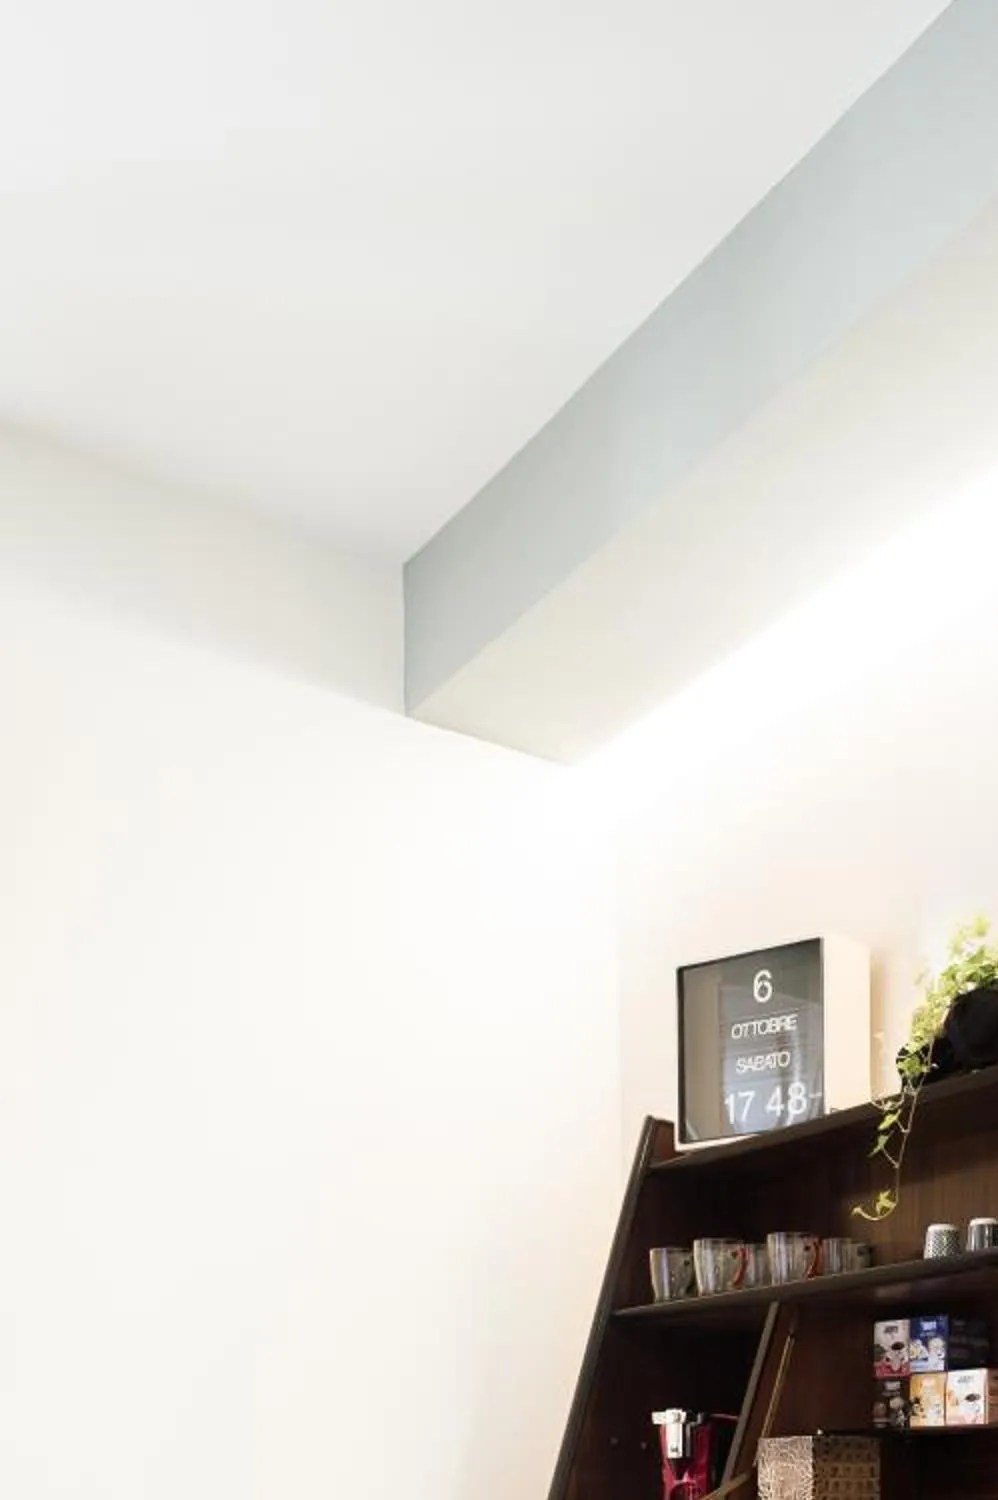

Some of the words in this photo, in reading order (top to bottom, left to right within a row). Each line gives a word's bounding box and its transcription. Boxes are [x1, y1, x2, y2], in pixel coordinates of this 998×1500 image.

[753, 969, 773, 1003] 6
[731, 1013, 798, 1039] OTTOBRE
[735, 1051, 791, 1074] SABATO
[724, 1090, 755, 1124] 17
[765, 1082, 807, 1117] 48
